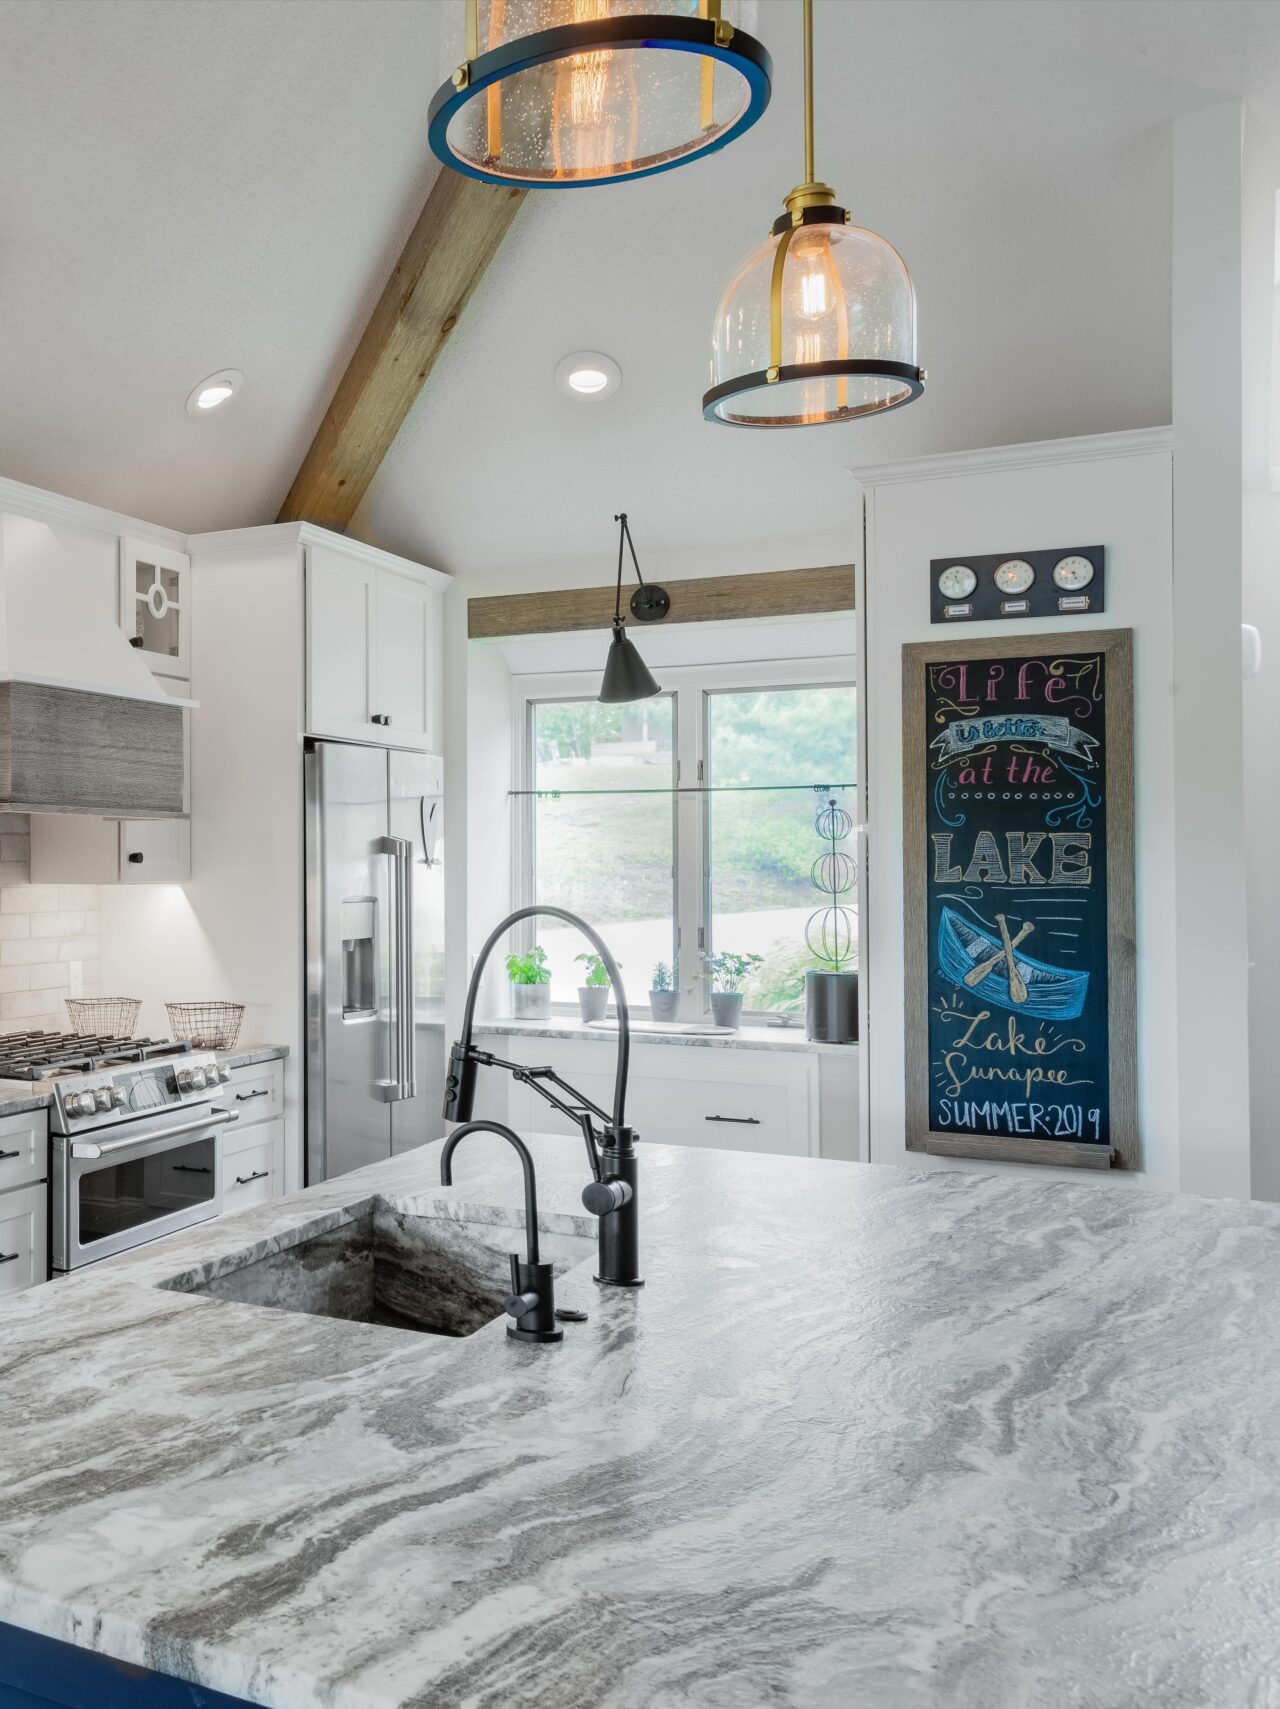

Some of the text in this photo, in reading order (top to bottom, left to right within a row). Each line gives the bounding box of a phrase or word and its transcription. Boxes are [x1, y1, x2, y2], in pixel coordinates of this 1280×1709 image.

[955, 718, 1046, 742] is better
[959, 756, 1056, 785] at the
[931, 831, 1092, 884] LAKE
[941, 1010, 1086, 1055] Lake
[945, 1052, 1094, 1098] Sunapee
